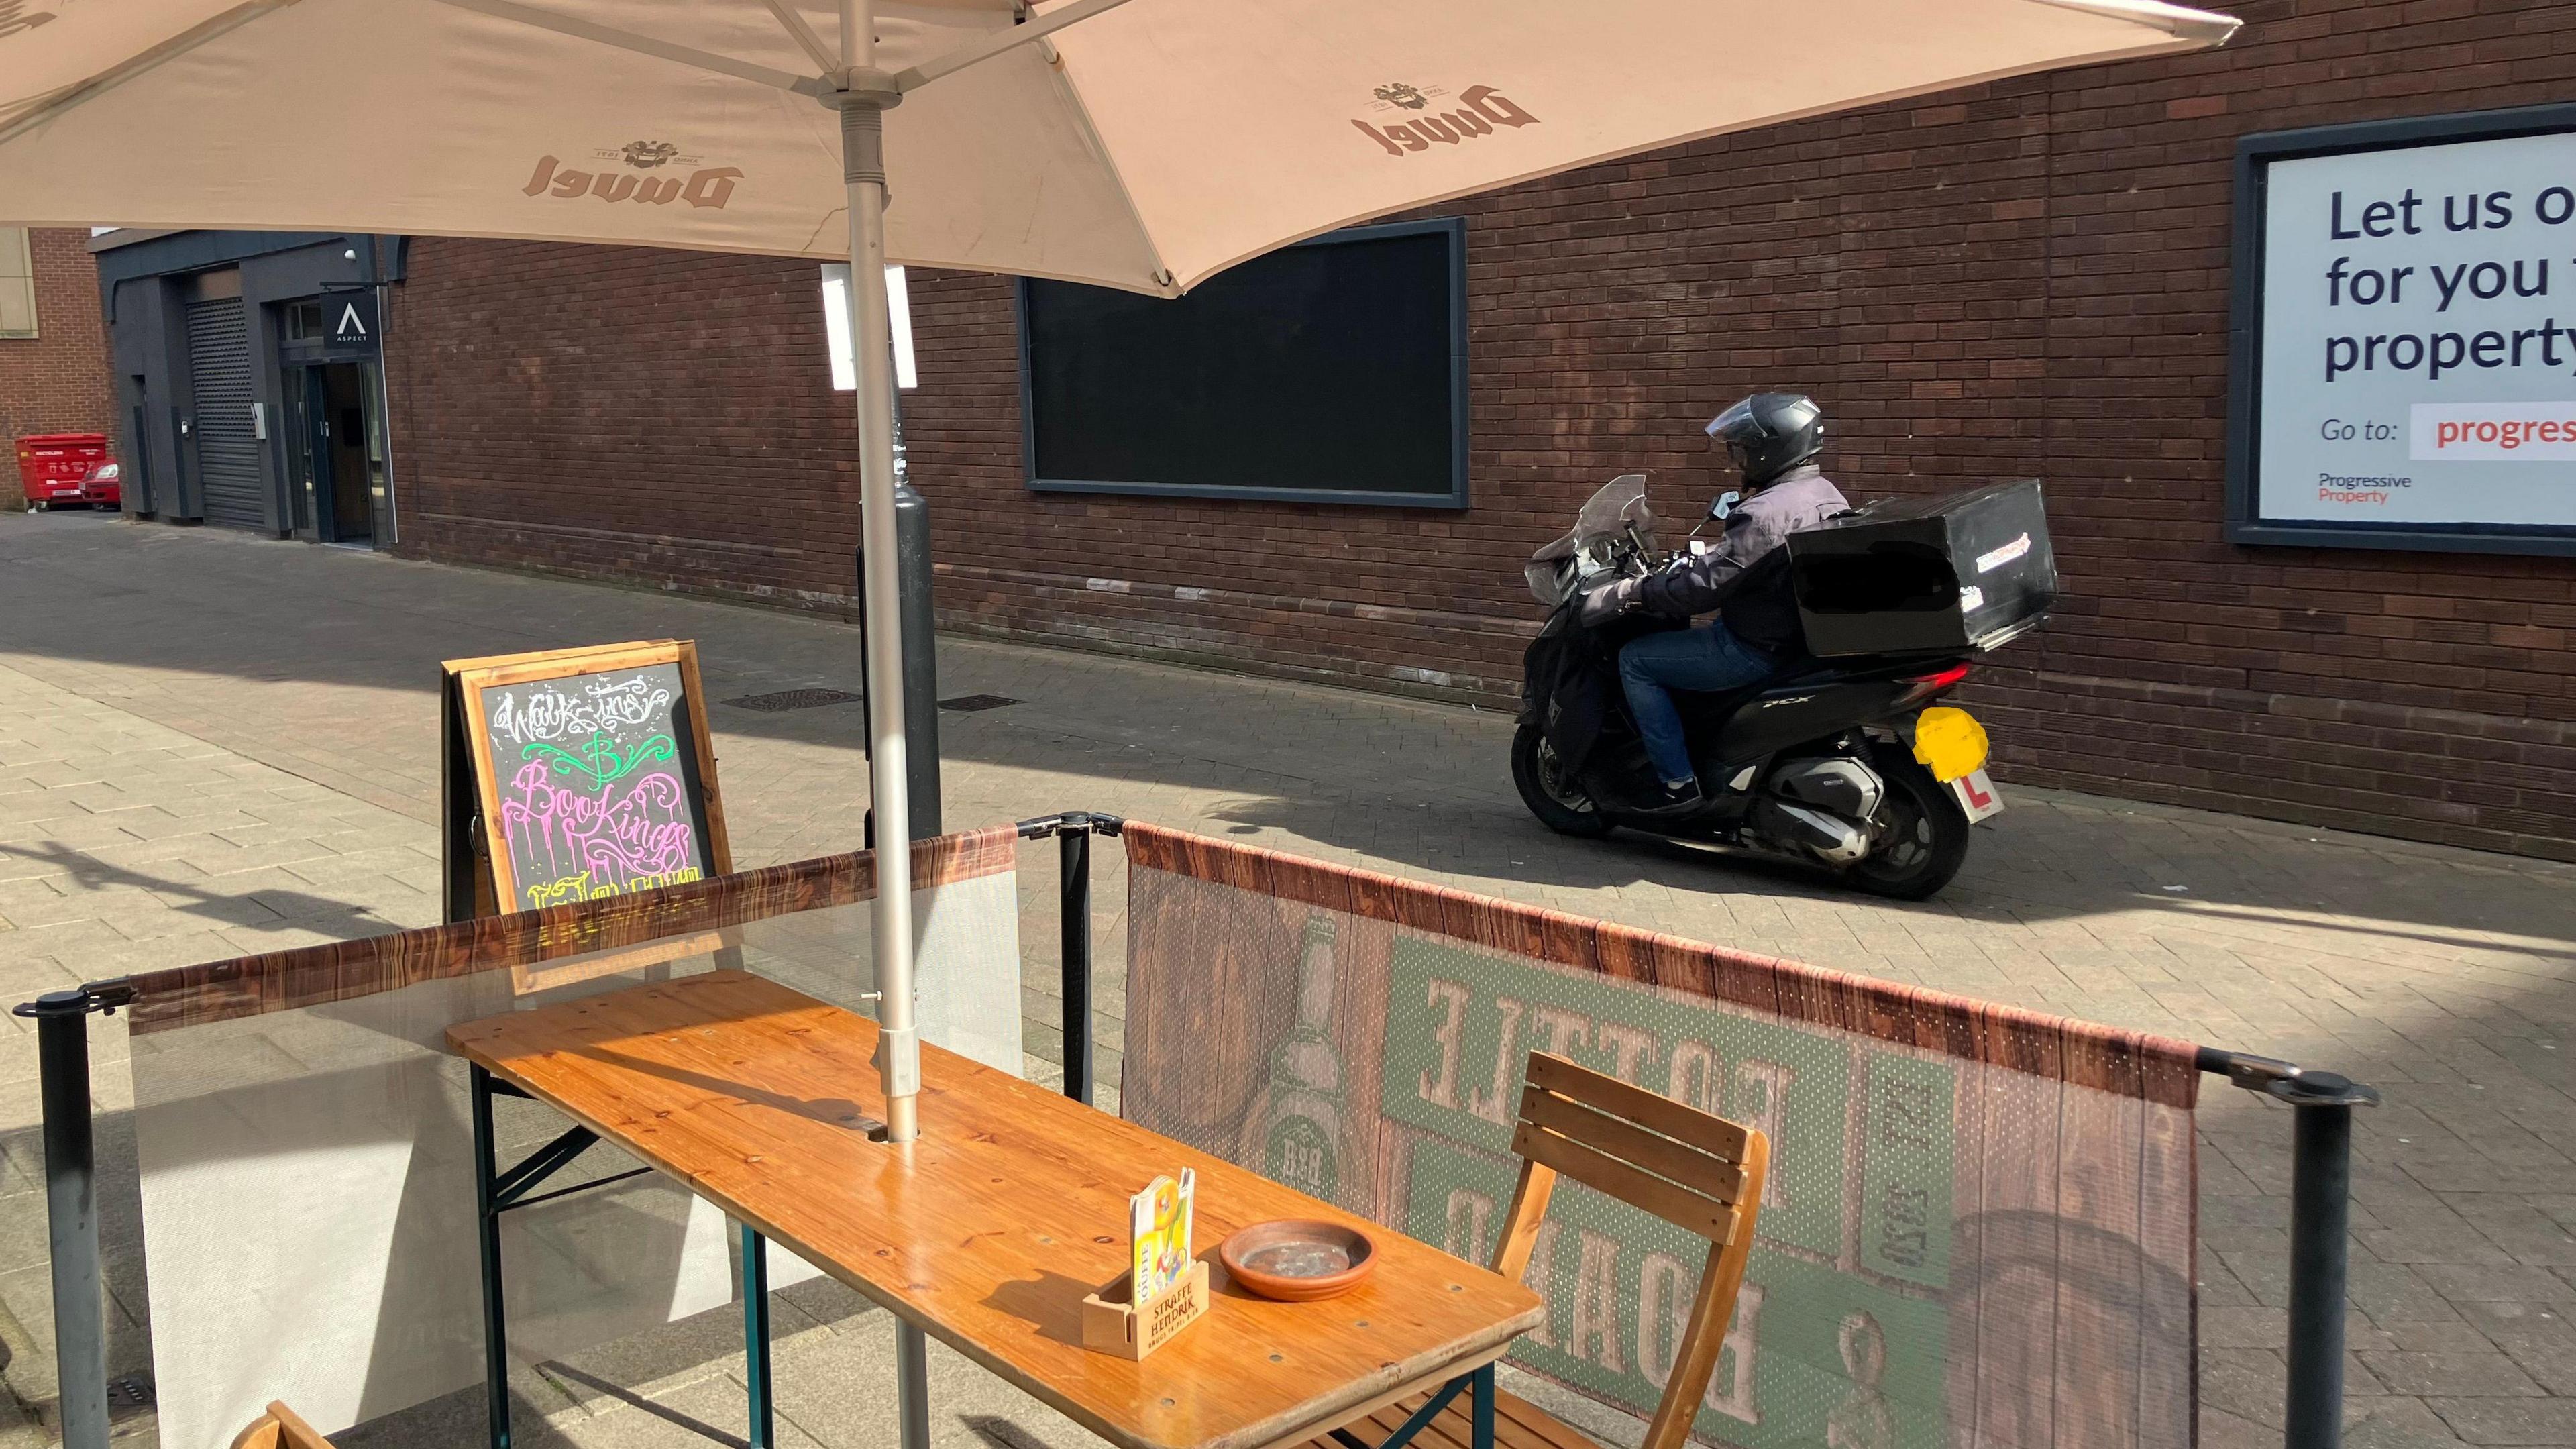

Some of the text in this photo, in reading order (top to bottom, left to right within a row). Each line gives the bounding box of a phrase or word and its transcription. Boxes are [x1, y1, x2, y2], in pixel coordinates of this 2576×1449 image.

[2330, 189, 2422, 240] Let
[2444, 191, 2512, 231] us
[2326, 256, 2548, 312] for you
[2321, 419, 2398, 441] Go to:
[2319, 473, 2412, 489] Progressive
[2319, 488, 2388, 504] Property
[1959, 775, 1992, 809] L
[503, 759, 690, 875] Bookings
[1154, 1282, 1191, 1320] STRAFFE
